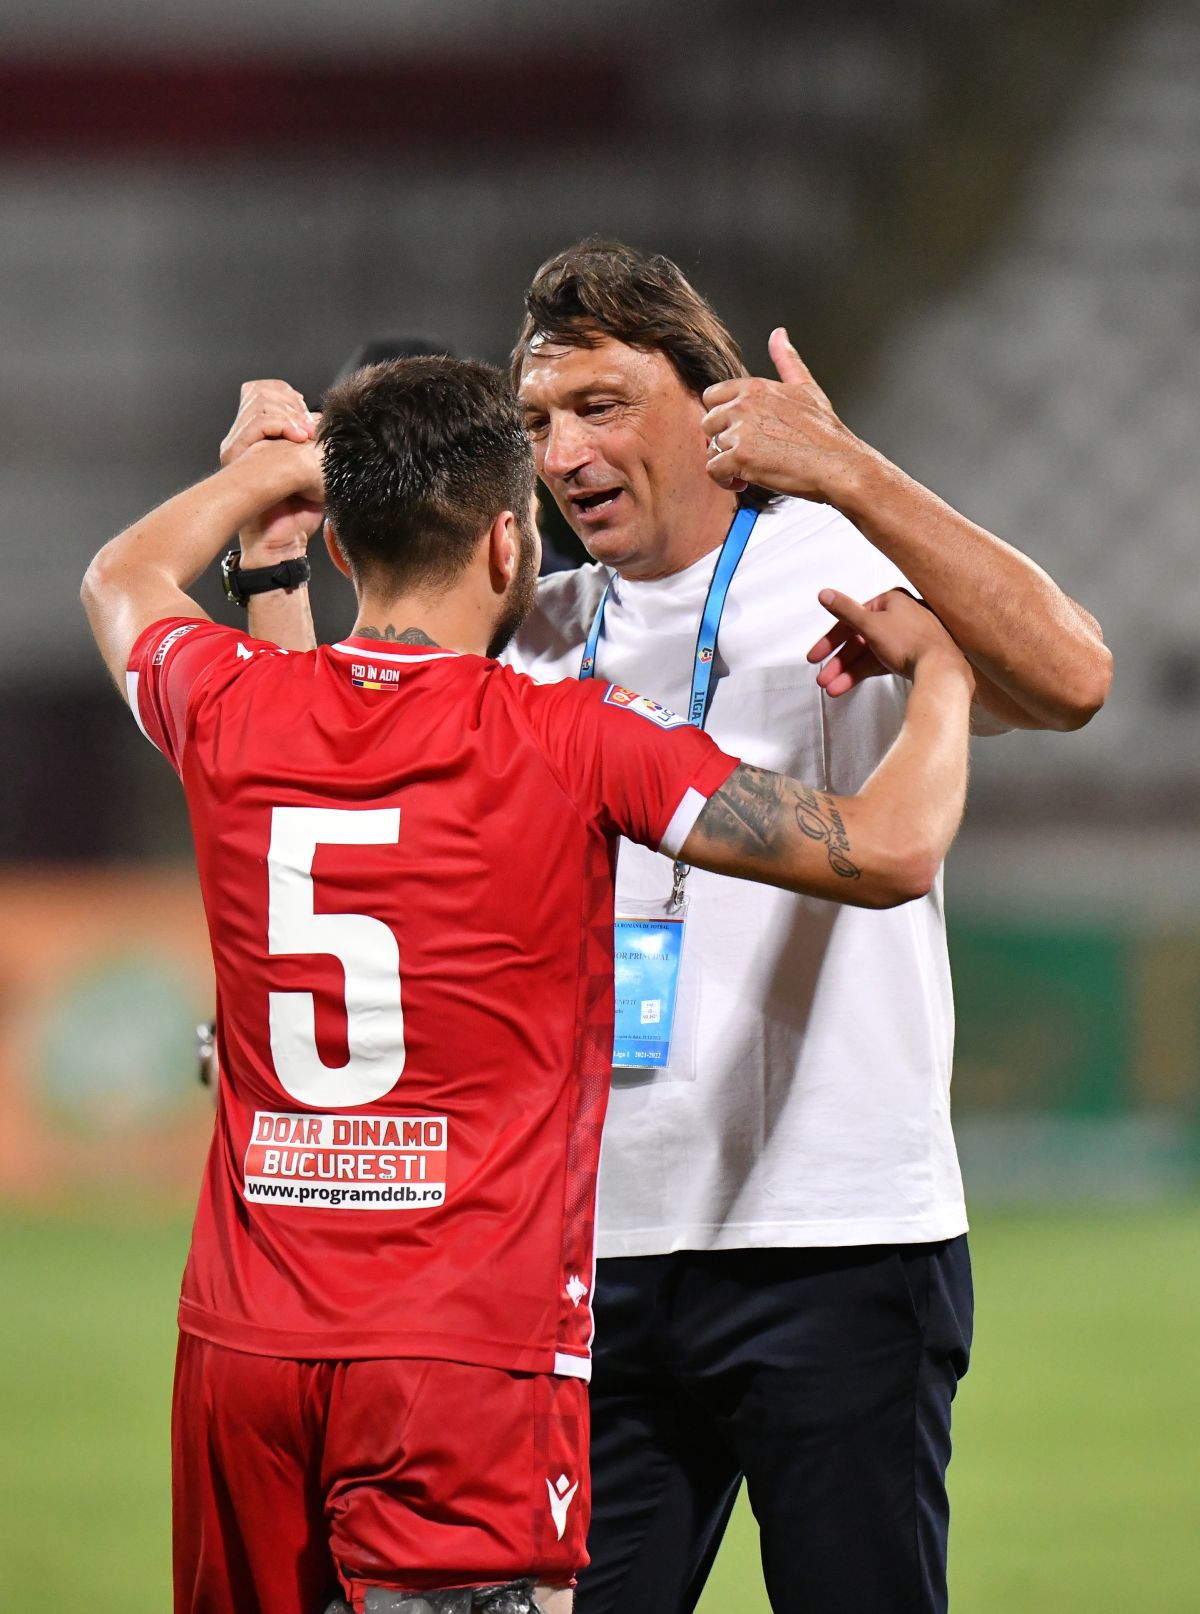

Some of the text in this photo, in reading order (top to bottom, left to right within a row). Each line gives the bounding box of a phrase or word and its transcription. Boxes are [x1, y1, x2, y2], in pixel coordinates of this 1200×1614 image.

[351, 663, 366, 678] FCD
[379, 668, 400, 682] ADN
[692, 691, 705, 720] LIGA
[267, 806, 406, 1108] 5
[256, 1116, 443, 1147] DOAR DINAMO
[248, 1182, 443, 1205] www.programddb.ro
